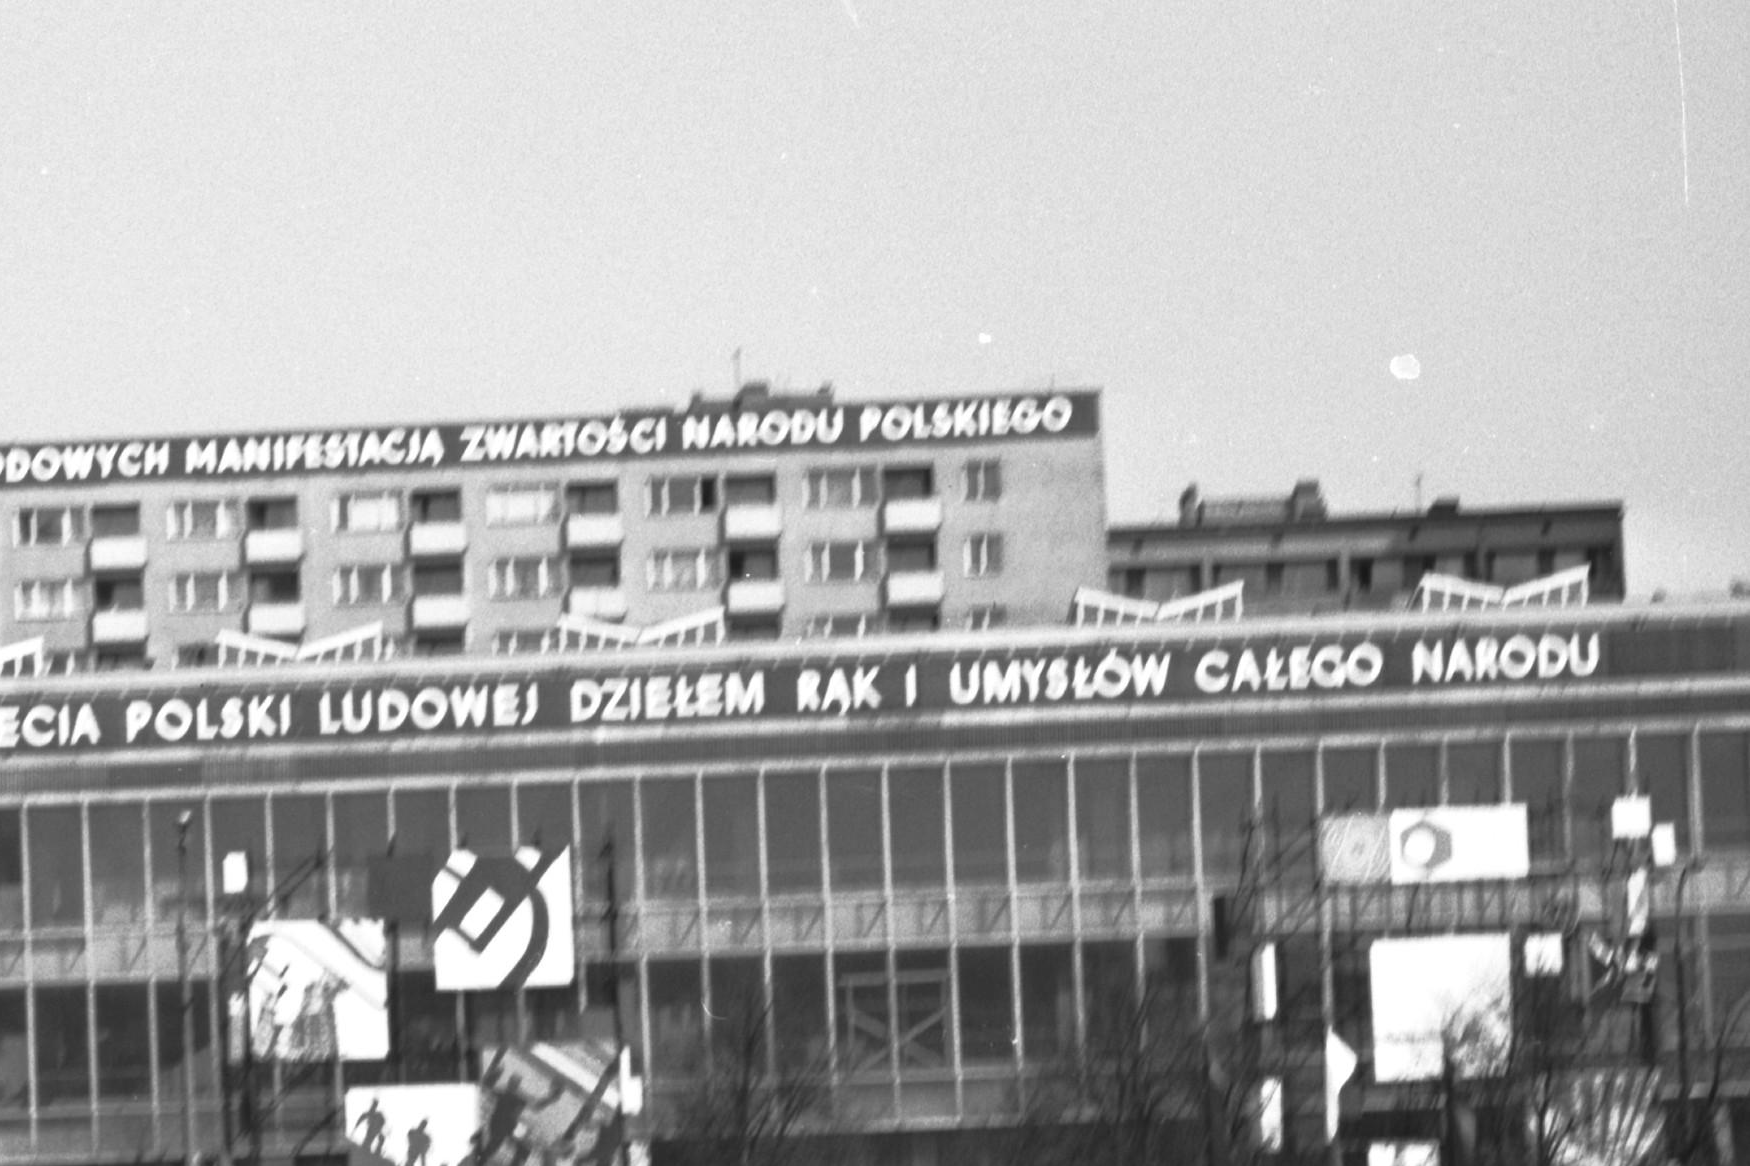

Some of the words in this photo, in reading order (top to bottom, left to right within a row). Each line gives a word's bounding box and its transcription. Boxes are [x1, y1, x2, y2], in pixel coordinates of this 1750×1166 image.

[184, 425, 446, 475] MANIFESTACJĄ
[459, 411, 668, 463] ZWARTOŚCI
[681, 406, 845, 451] NARODU
[858, 394, 1074, 443] POLSKIEGO
[124, 689, 292, 744] POLSKI
[317, 681, 540, 735] LUDOWEJ
[569, 670, 766, 724] DZIEŁEM
[796, 665, 882, 715] RĄK
[903, 663, 918, 708] I
[948, 648, 1173, 706] UMYSŁÓW
[1193, 639, 1385, 694] CAŁEGO
[1410, 632, 1602, 684] NARODU
